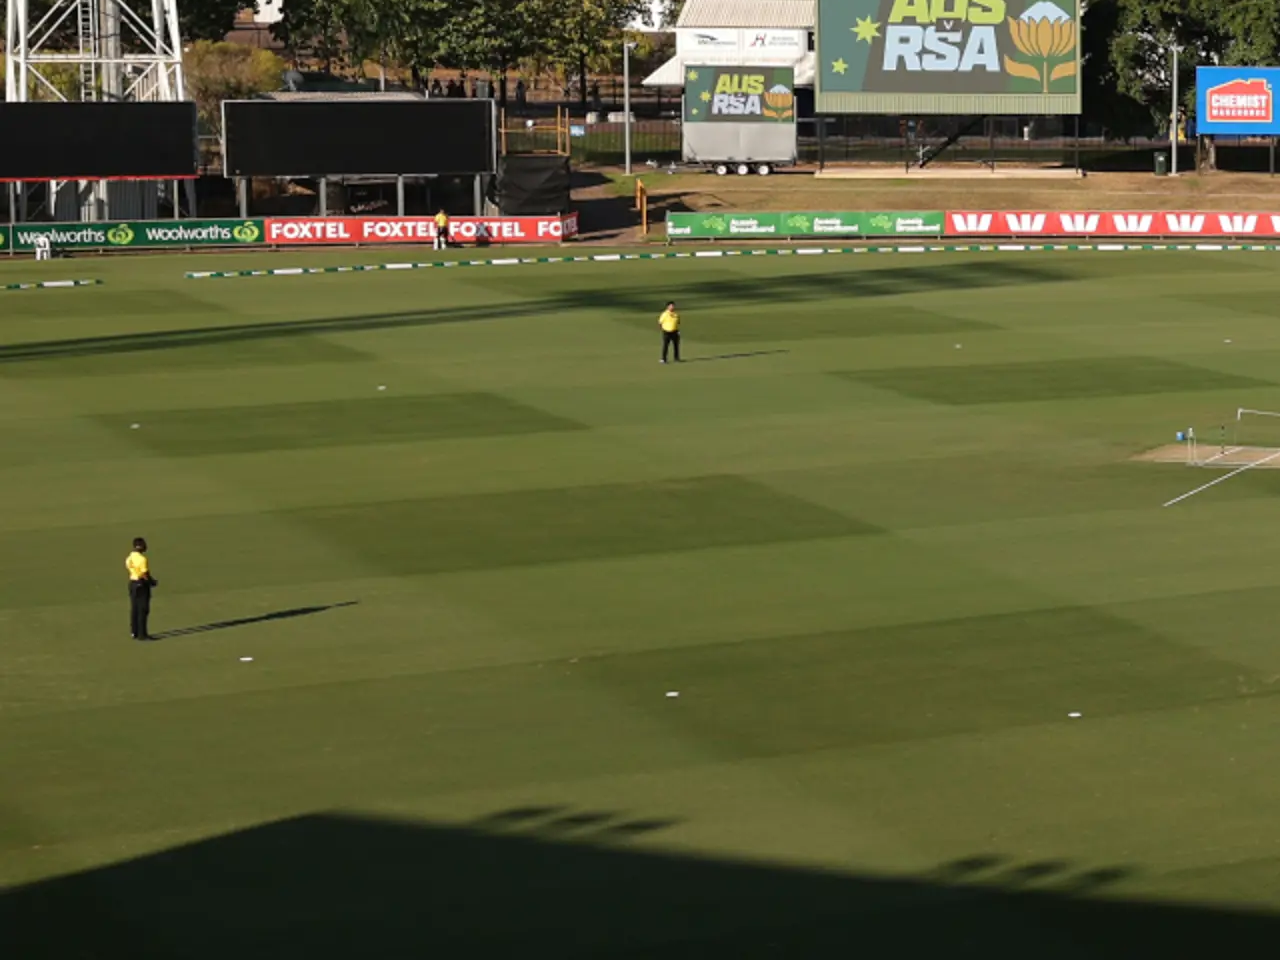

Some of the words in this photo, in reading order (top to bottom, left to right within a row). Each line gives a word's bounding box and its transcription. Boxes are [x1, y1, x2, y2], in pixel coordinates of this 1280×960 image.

[882, 25, 1001, 71] RSA
[715, 74, 765, 94] AUS
[711, 94, 761, 114] RSA
[1211, 94, 1268, 108] CHEMIST
[271, 221, 350, 239] FOXTEL
[363, 221, 437, 238] FOXTEL
[449, 221, 525, 237] FOXTEL
